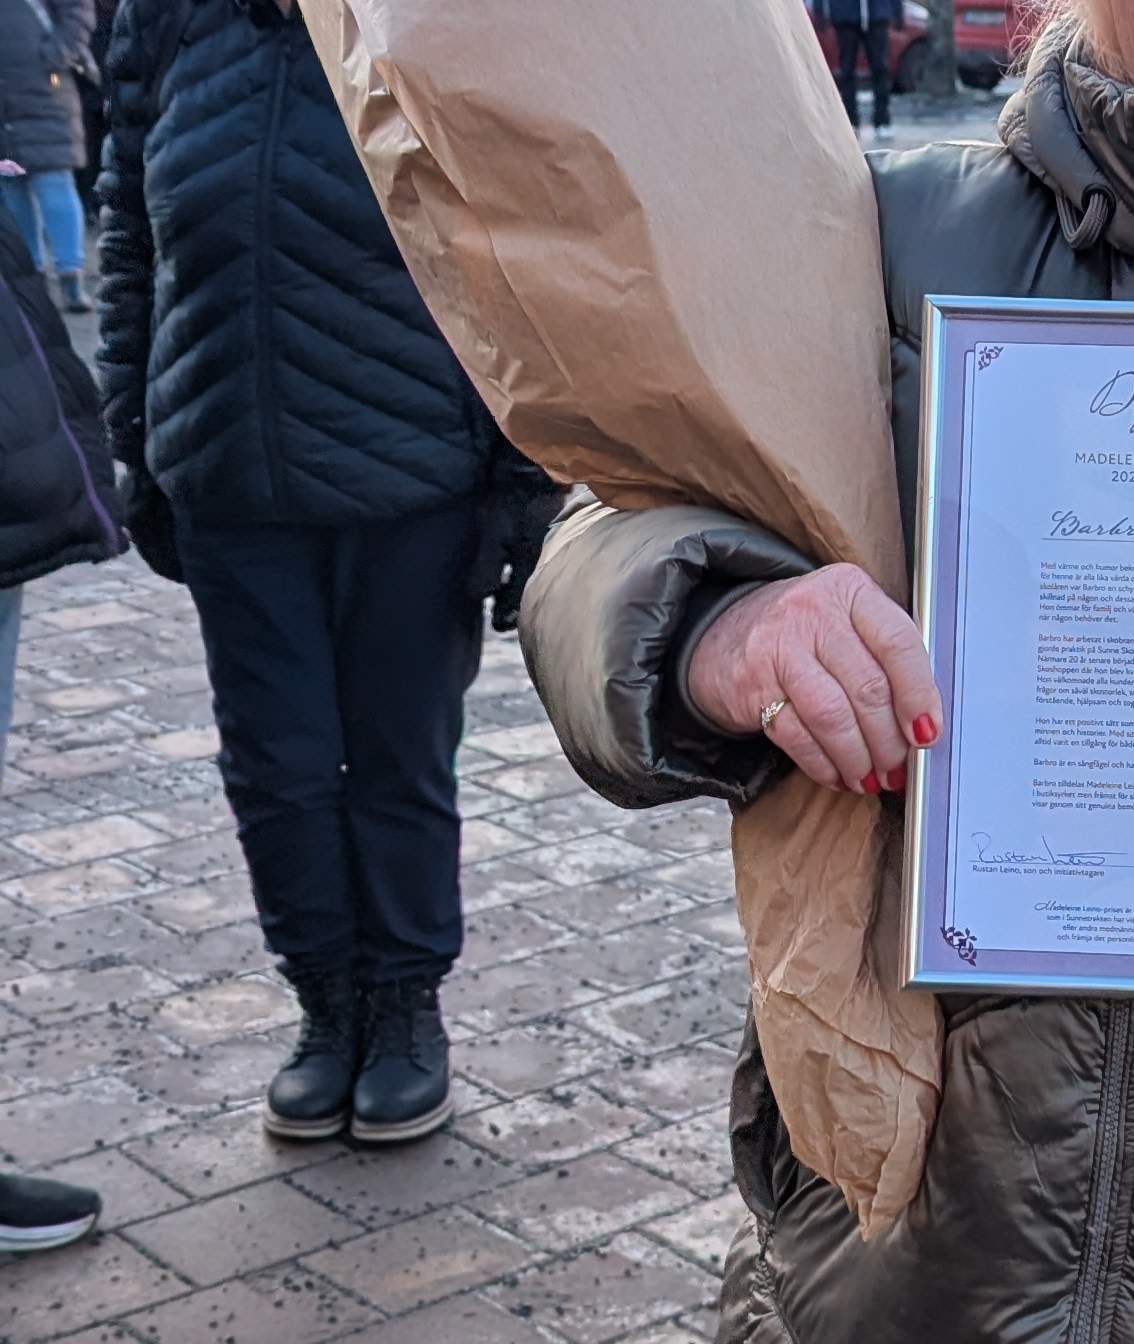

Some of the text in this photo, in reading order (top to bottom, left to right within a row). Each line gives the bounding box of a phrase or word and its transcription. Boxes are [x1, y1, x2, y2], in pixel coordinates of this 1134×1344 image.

[1081, 563, 1094, 571] och
[1083, 583, 1106, 592] Barbro
[1100, 594, 1114, 602] och
[1113, 605, 1126, 613] och
[1039, 634, 1062, 642] Barbro
[1069, 655, 1078, 663] 20
[1110, 666, 1124, 675] blev
[1109, 698, 1122, 706] och
[1062, 728, 1075, 736] och
[1034, 758, 1058, 766] Barbro
[1033, 778, 1056, 787] Barbro
[973, 864, 998, 873] Rustan
[1039, 866, 1052, 874] och
